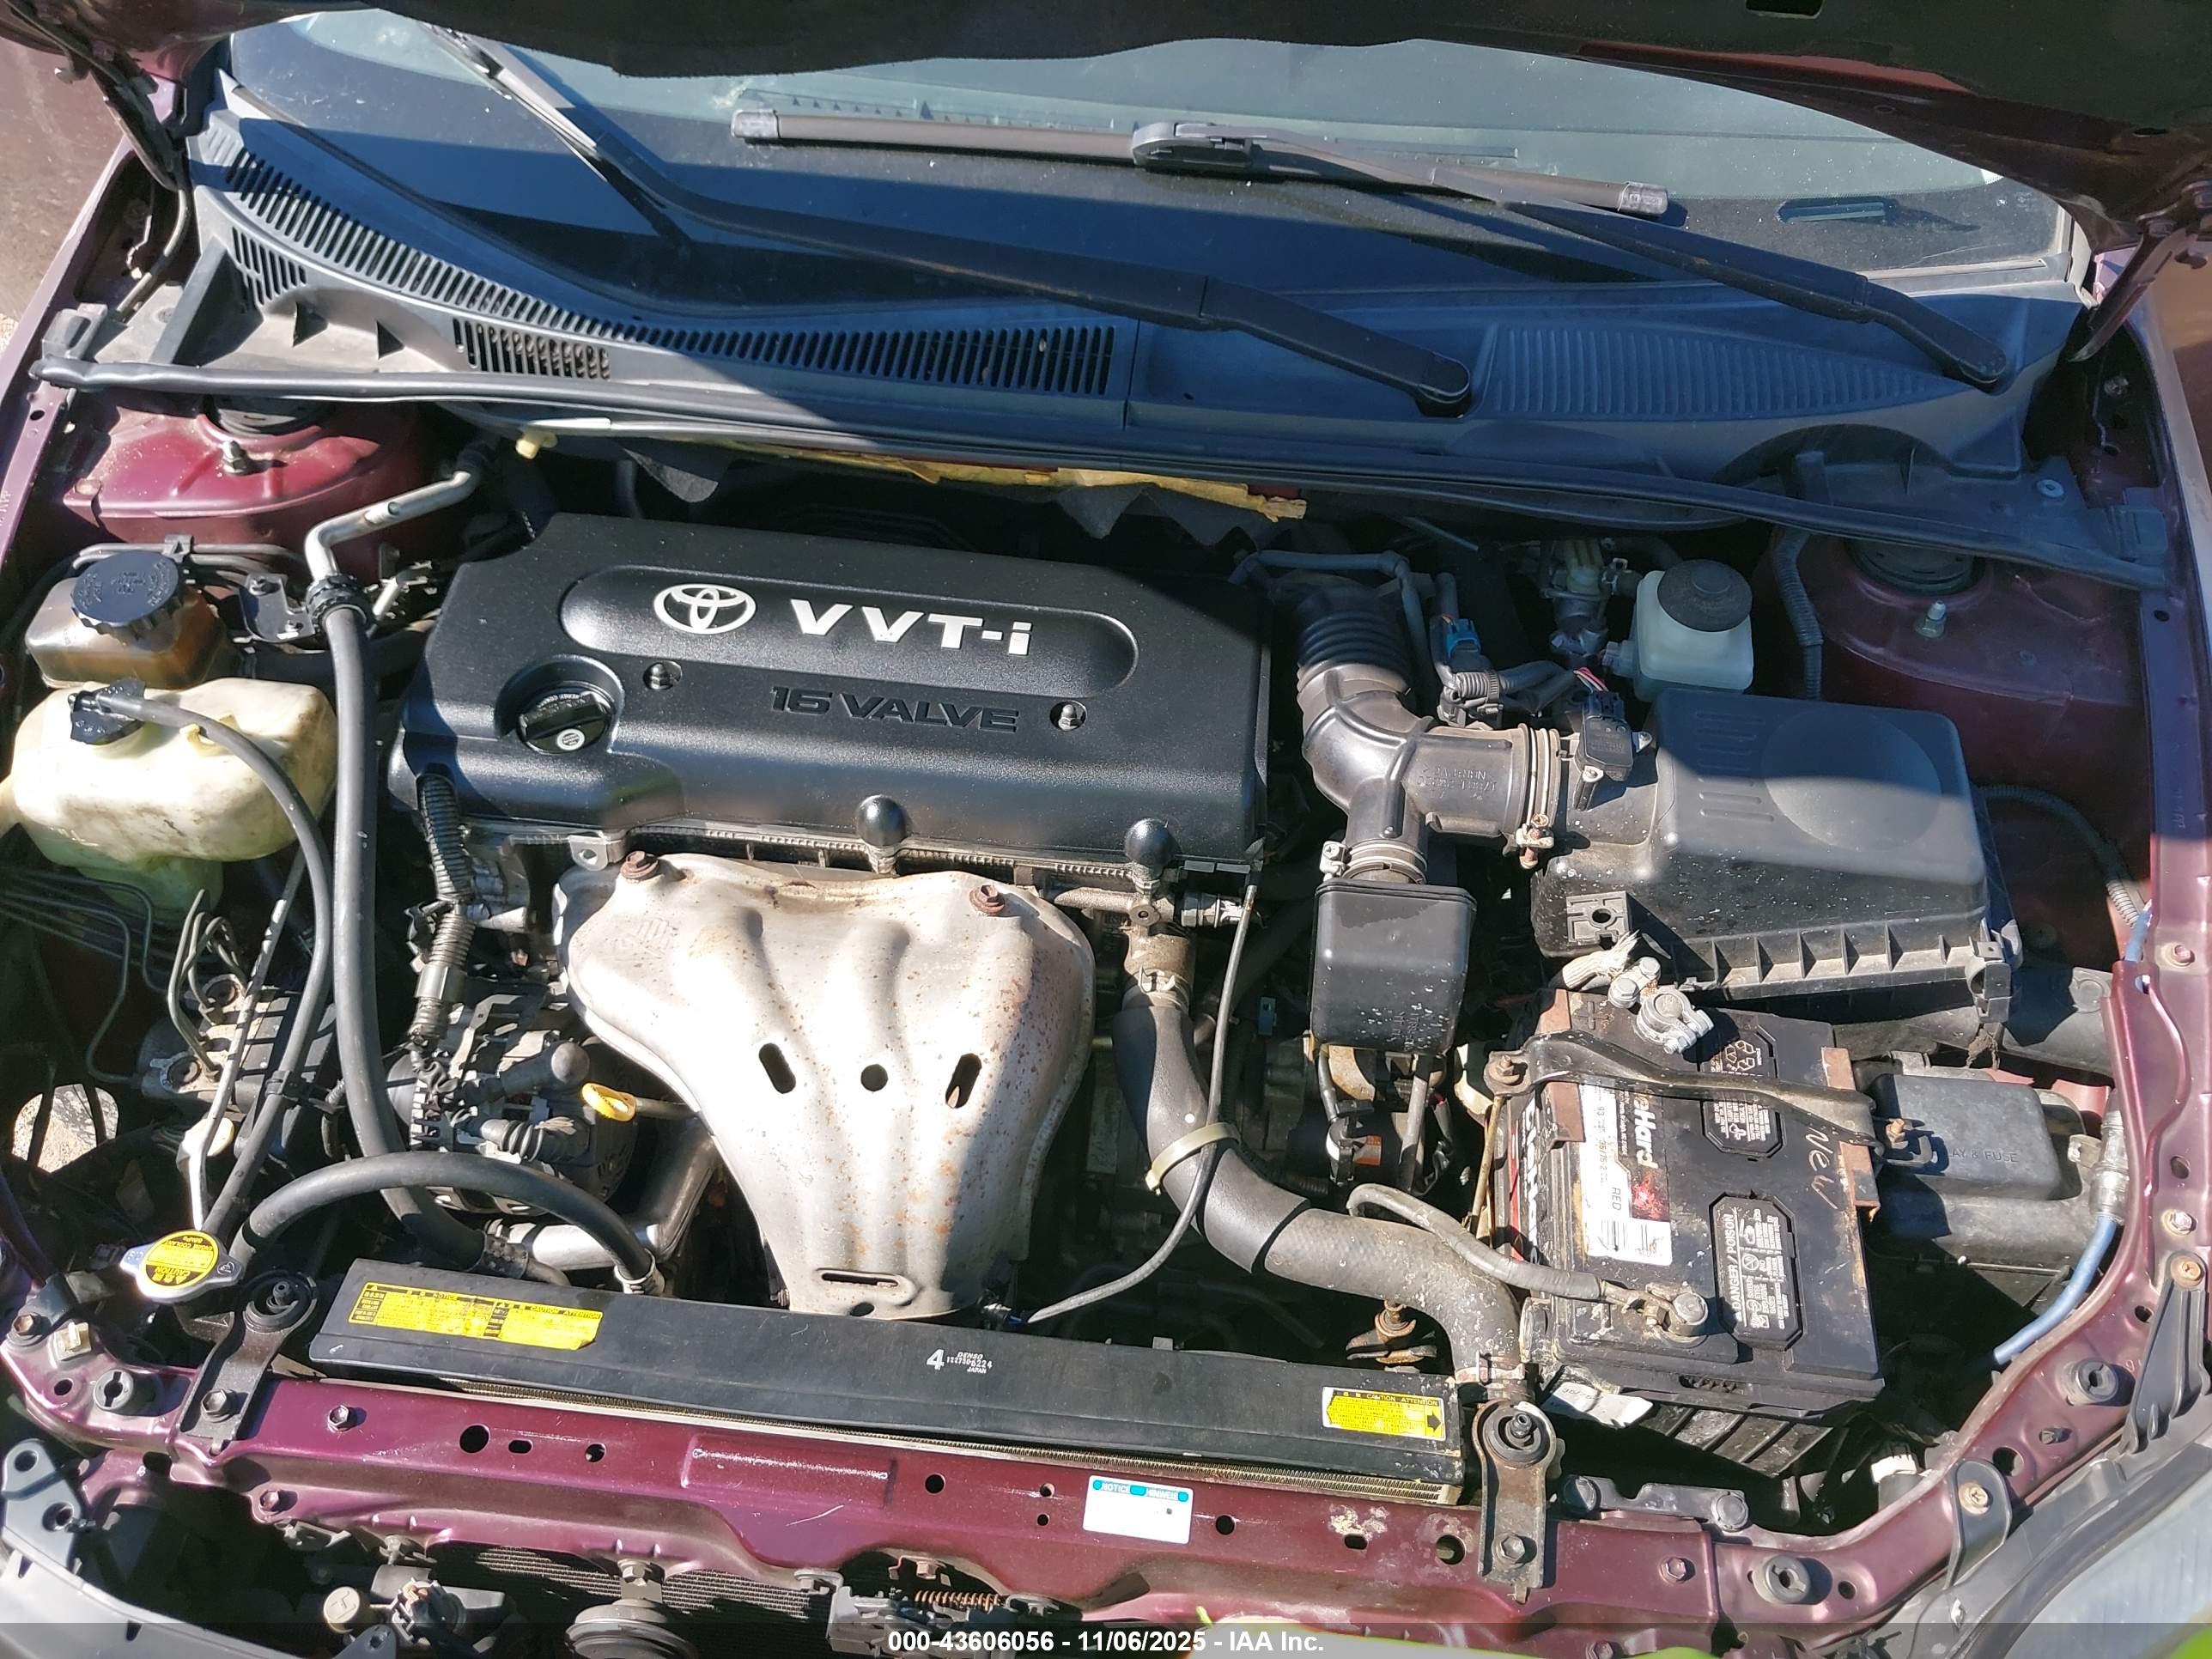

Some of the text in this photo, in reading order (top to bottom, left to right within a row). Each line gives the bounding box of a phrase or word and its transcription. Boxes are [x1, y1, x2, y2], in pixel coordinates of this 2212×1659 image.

[789, 598, 1034, 656] VVT-i
[771, 686, 1019, 733] 16 VALVE
[1984, 1151, 2020, 1163] FUSE
[1611, 1187, 1621, 1211] RED
[1723, 1213, 1736, 1254] POISON
[1729, 1265, 1741, 1310] DANGER
[531, 1305, 560, 1315] CAUTION
[563, 1310, 602, 1320] ATTENTION
[927, 1348, 945, 1370] 4
[957, 1352, 983, 1360] DENSO
[1366, 1394, 1396, 1402] CAUTION
[1401, 1397, 1438, 1407] ATTENTION
